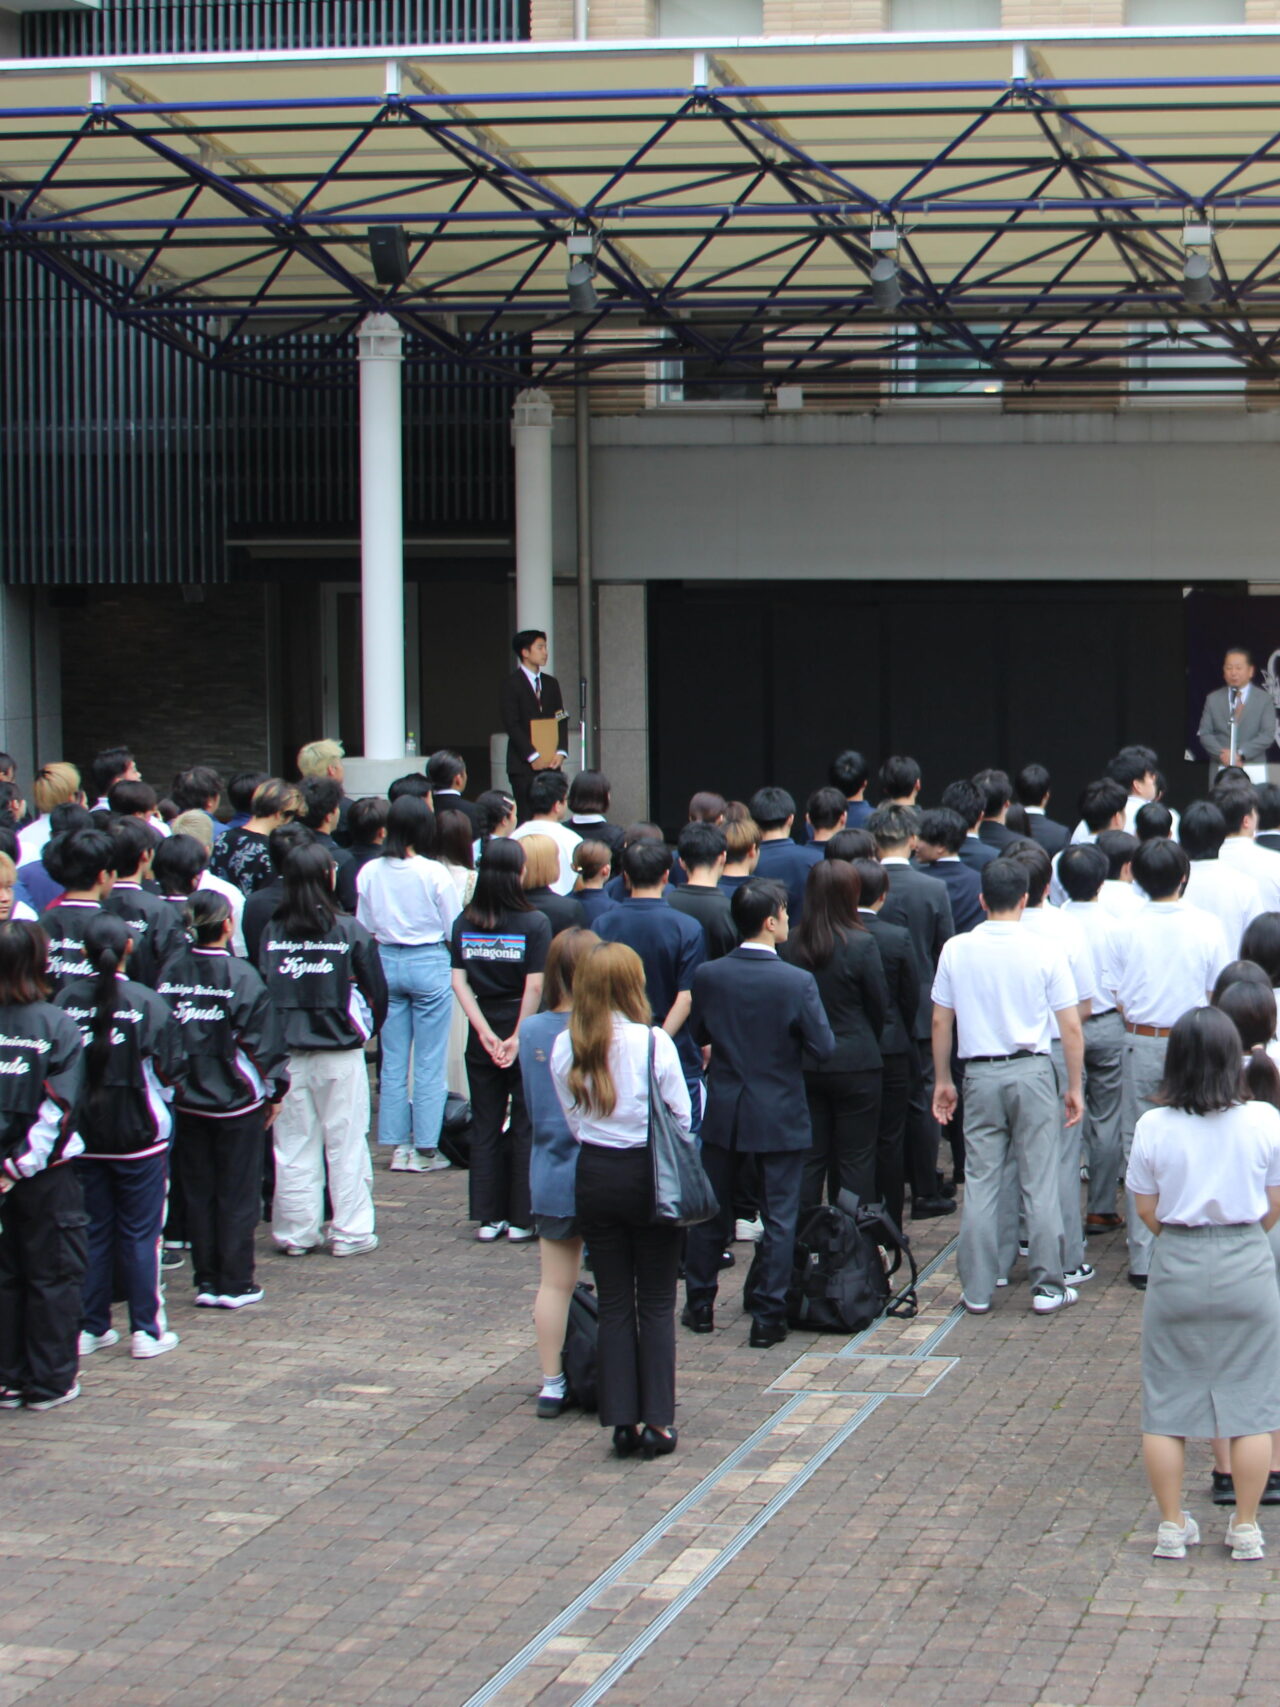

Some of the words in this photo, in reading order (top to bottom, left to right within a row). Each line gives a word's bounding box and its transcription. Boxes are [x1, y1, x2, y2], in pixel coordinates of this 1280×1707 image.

[304, 940, 350, 954] University
[466, 947, 521, 960] patagonia
[278, 957, 334, 979] Kyudo
